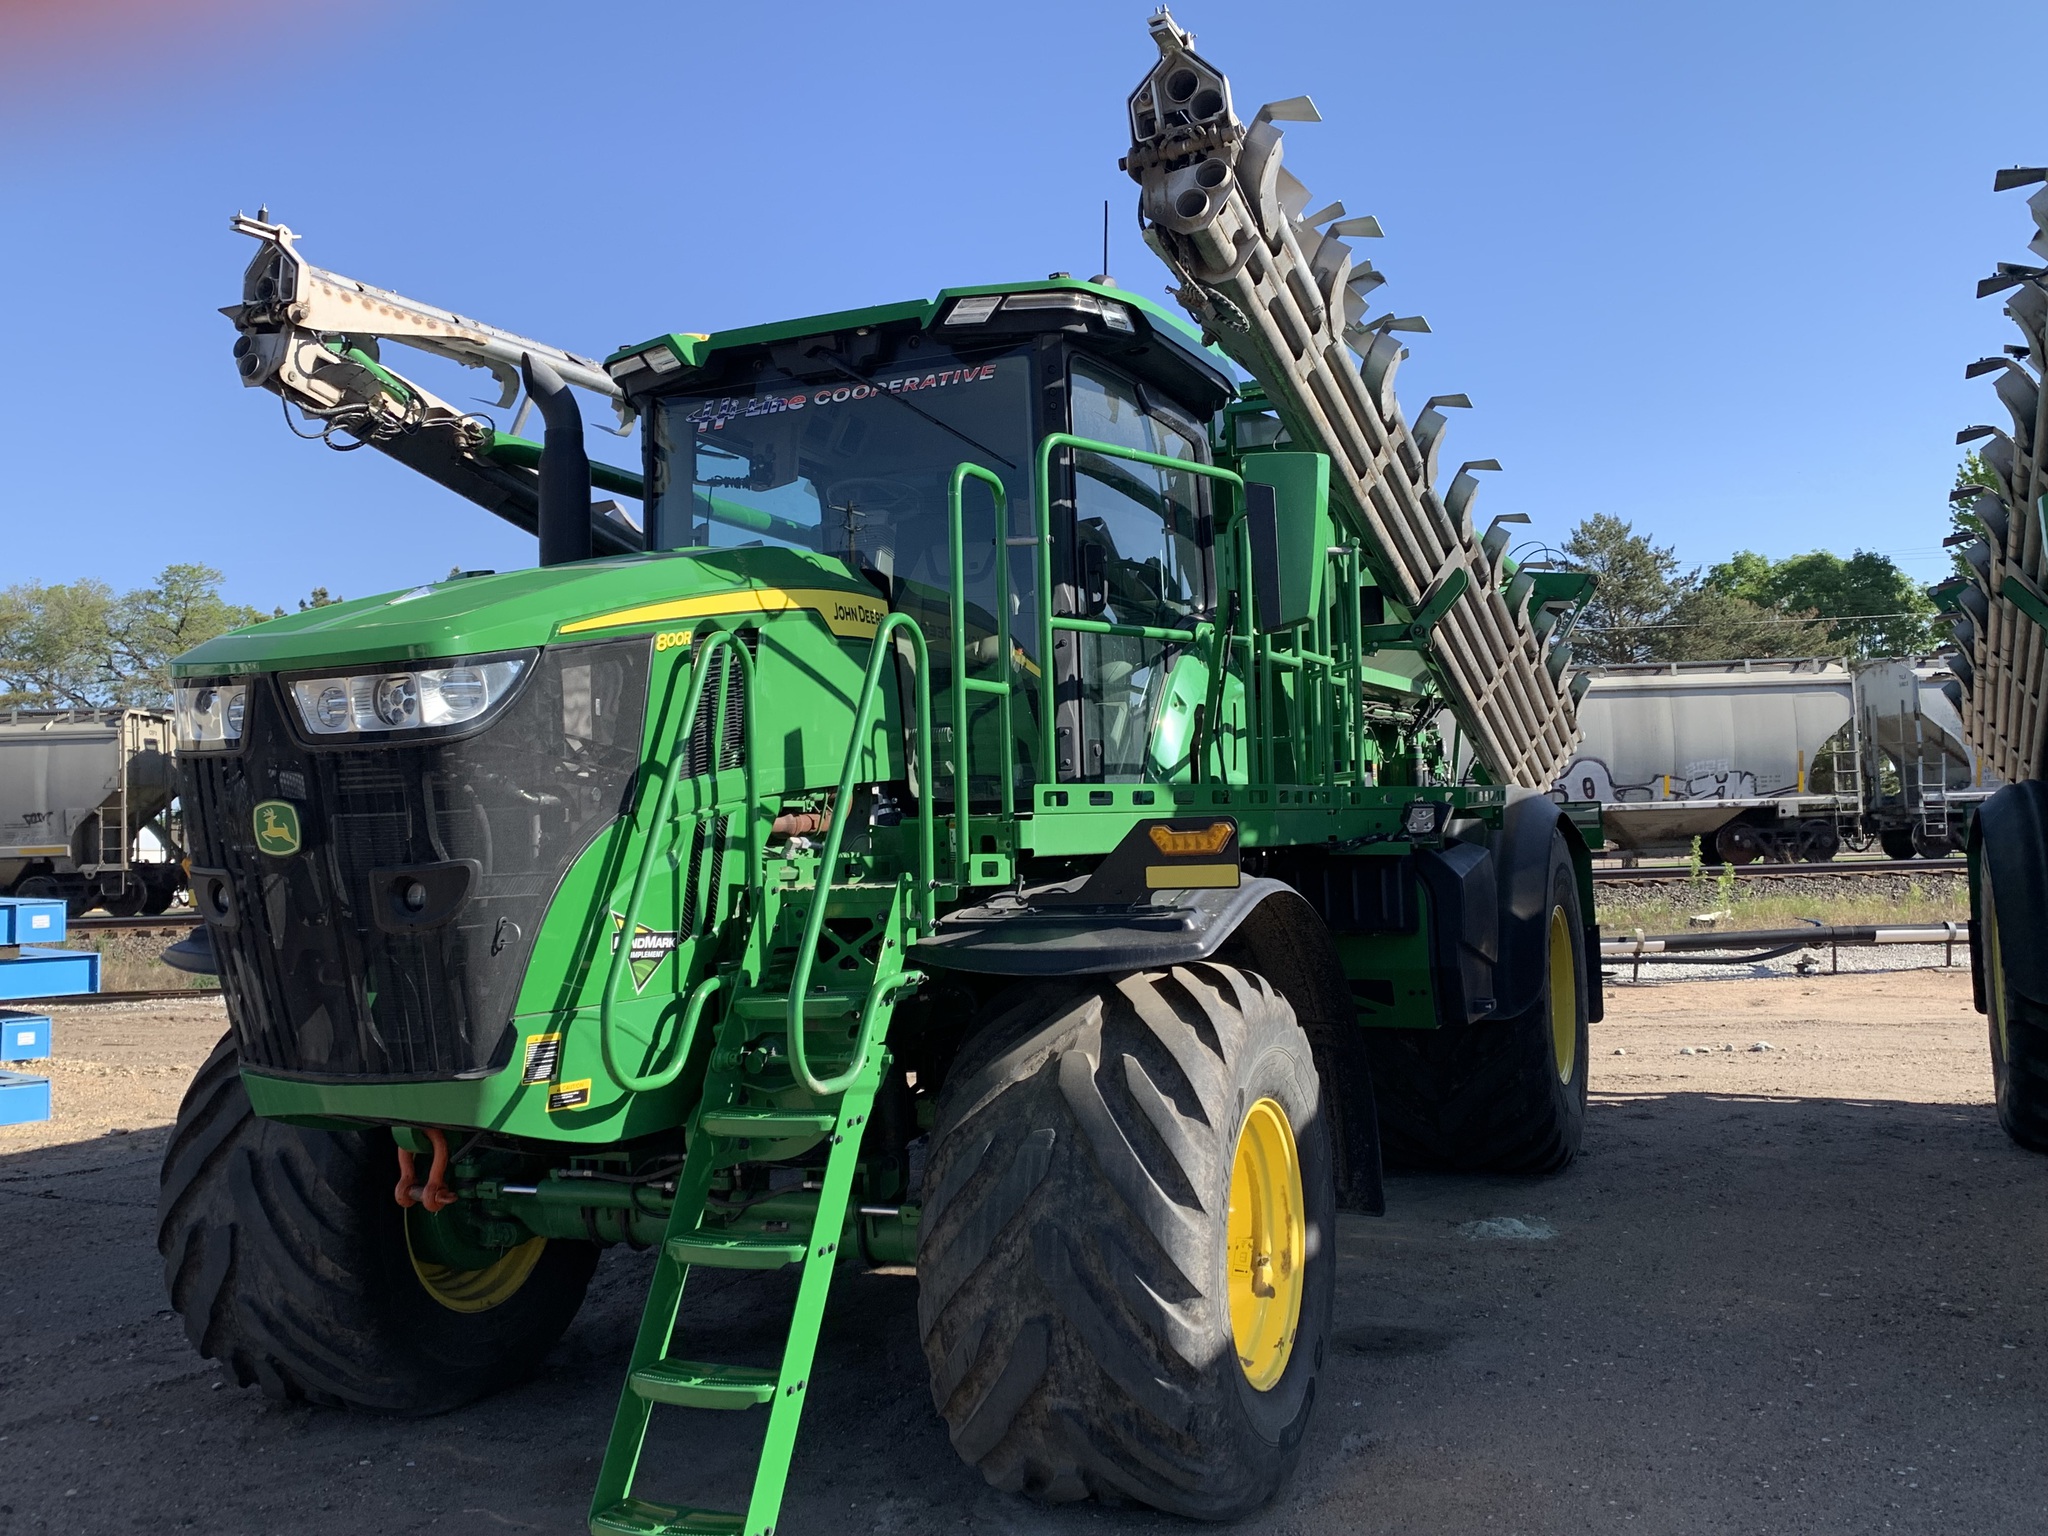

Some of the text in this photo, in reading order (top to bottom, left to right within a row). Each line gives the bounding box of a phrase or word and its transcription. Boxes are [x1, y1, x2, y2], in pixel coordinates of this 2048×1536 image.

[813, 364, 997, 405] COOPERATIVE
[834, 602, 858, 621] JOHN
[656, 630, 692, 652] 800R
[613, 936, 676, 950] LNDMARK
